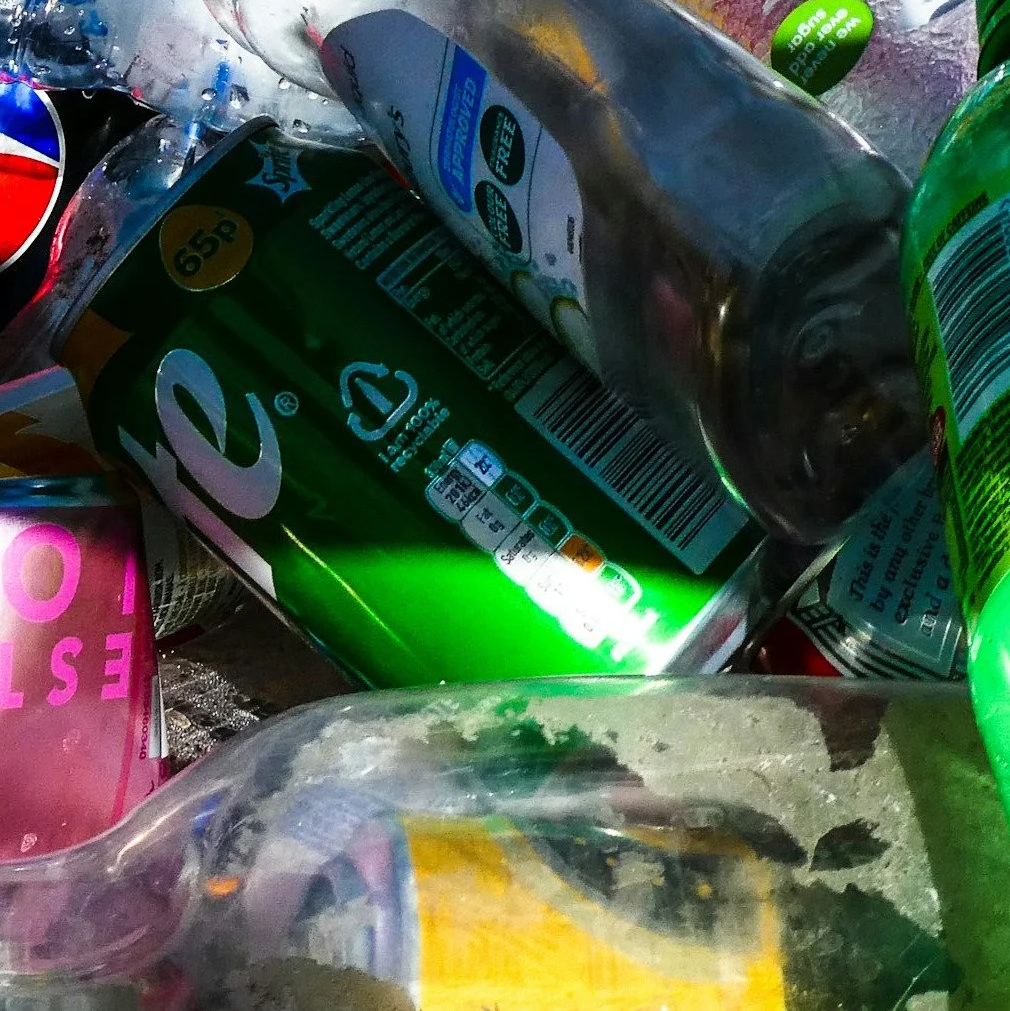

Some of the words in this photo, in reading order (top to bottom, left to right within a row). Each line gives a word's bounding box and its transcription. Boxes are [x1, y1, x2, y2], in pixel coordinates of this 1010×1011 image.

[789, 6, 827, 52] sugar
[817, 7, 849, 43] ever
[836, 15, 861, 40] we
[495, 119, 517, 180] FREE
[174, 217, 241, 278] 65p
[388, 401, 452, 477] recyclable
[402, 392, 441, 436] 100%
[474, 505, 493, 525] Fat
[499, 525, 535, 567] Saturates
[849, 562, 877, 601] This
[869, 512, 892, 541] the
[870, 584, 892, 613] by
[884, 546, 909, 583] any
[898, 498, 928, 542] other
[894, 530, 940, 625] exclusive
